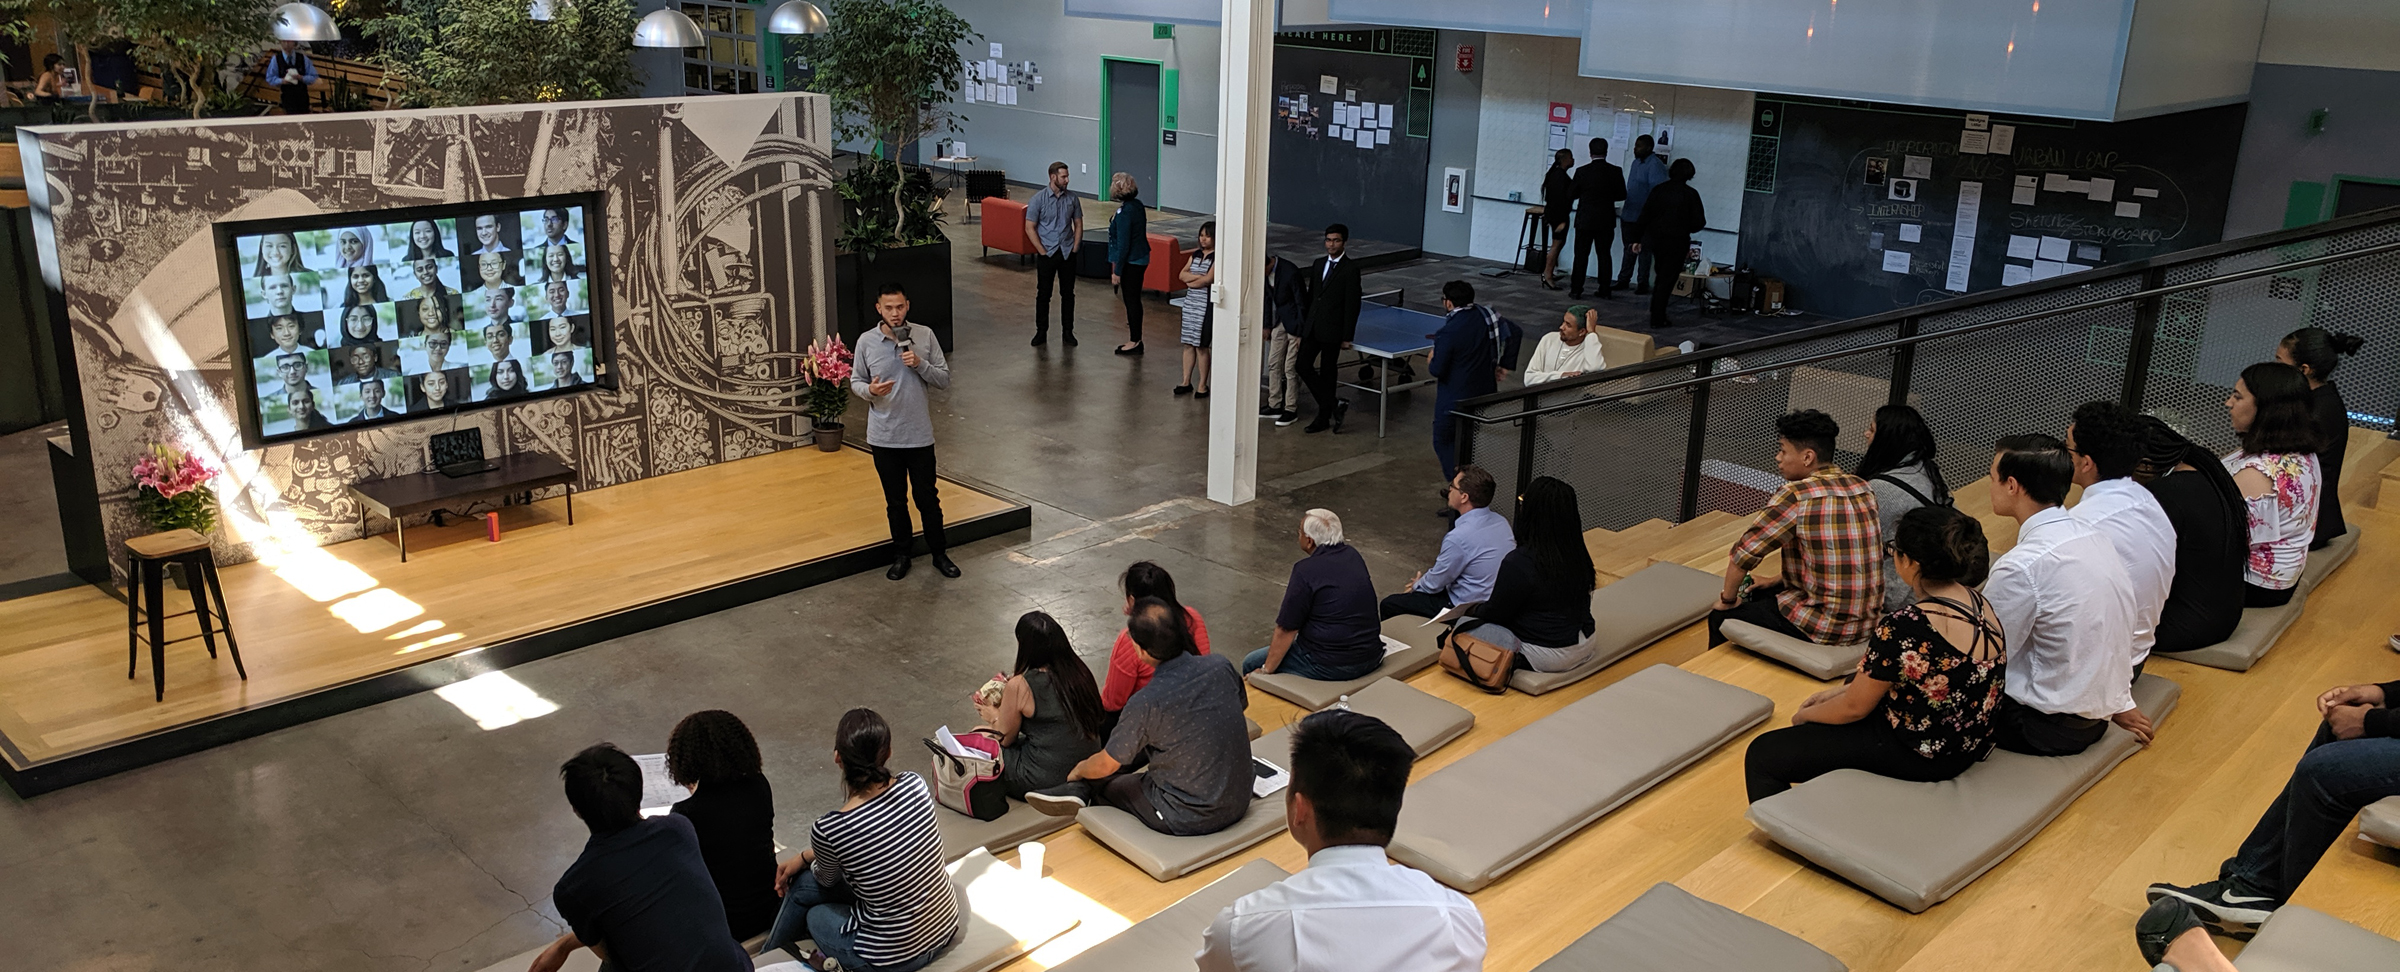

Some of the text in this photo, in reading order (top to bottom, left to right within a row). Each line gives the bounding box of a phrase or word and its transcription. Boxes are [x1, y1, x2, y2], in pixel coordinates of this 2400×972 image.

[1158, 26, 1168, 35] 270
[1322, 32, 1352, 43] HERE
[1166, 115, 1175, 124] 270
[1885, 139, 1960, 156] INSPIRATION
[2012, 146, 2119, 171] URBAN LEAP
[1867, 202, 1925, 218] INTERNSHIP
